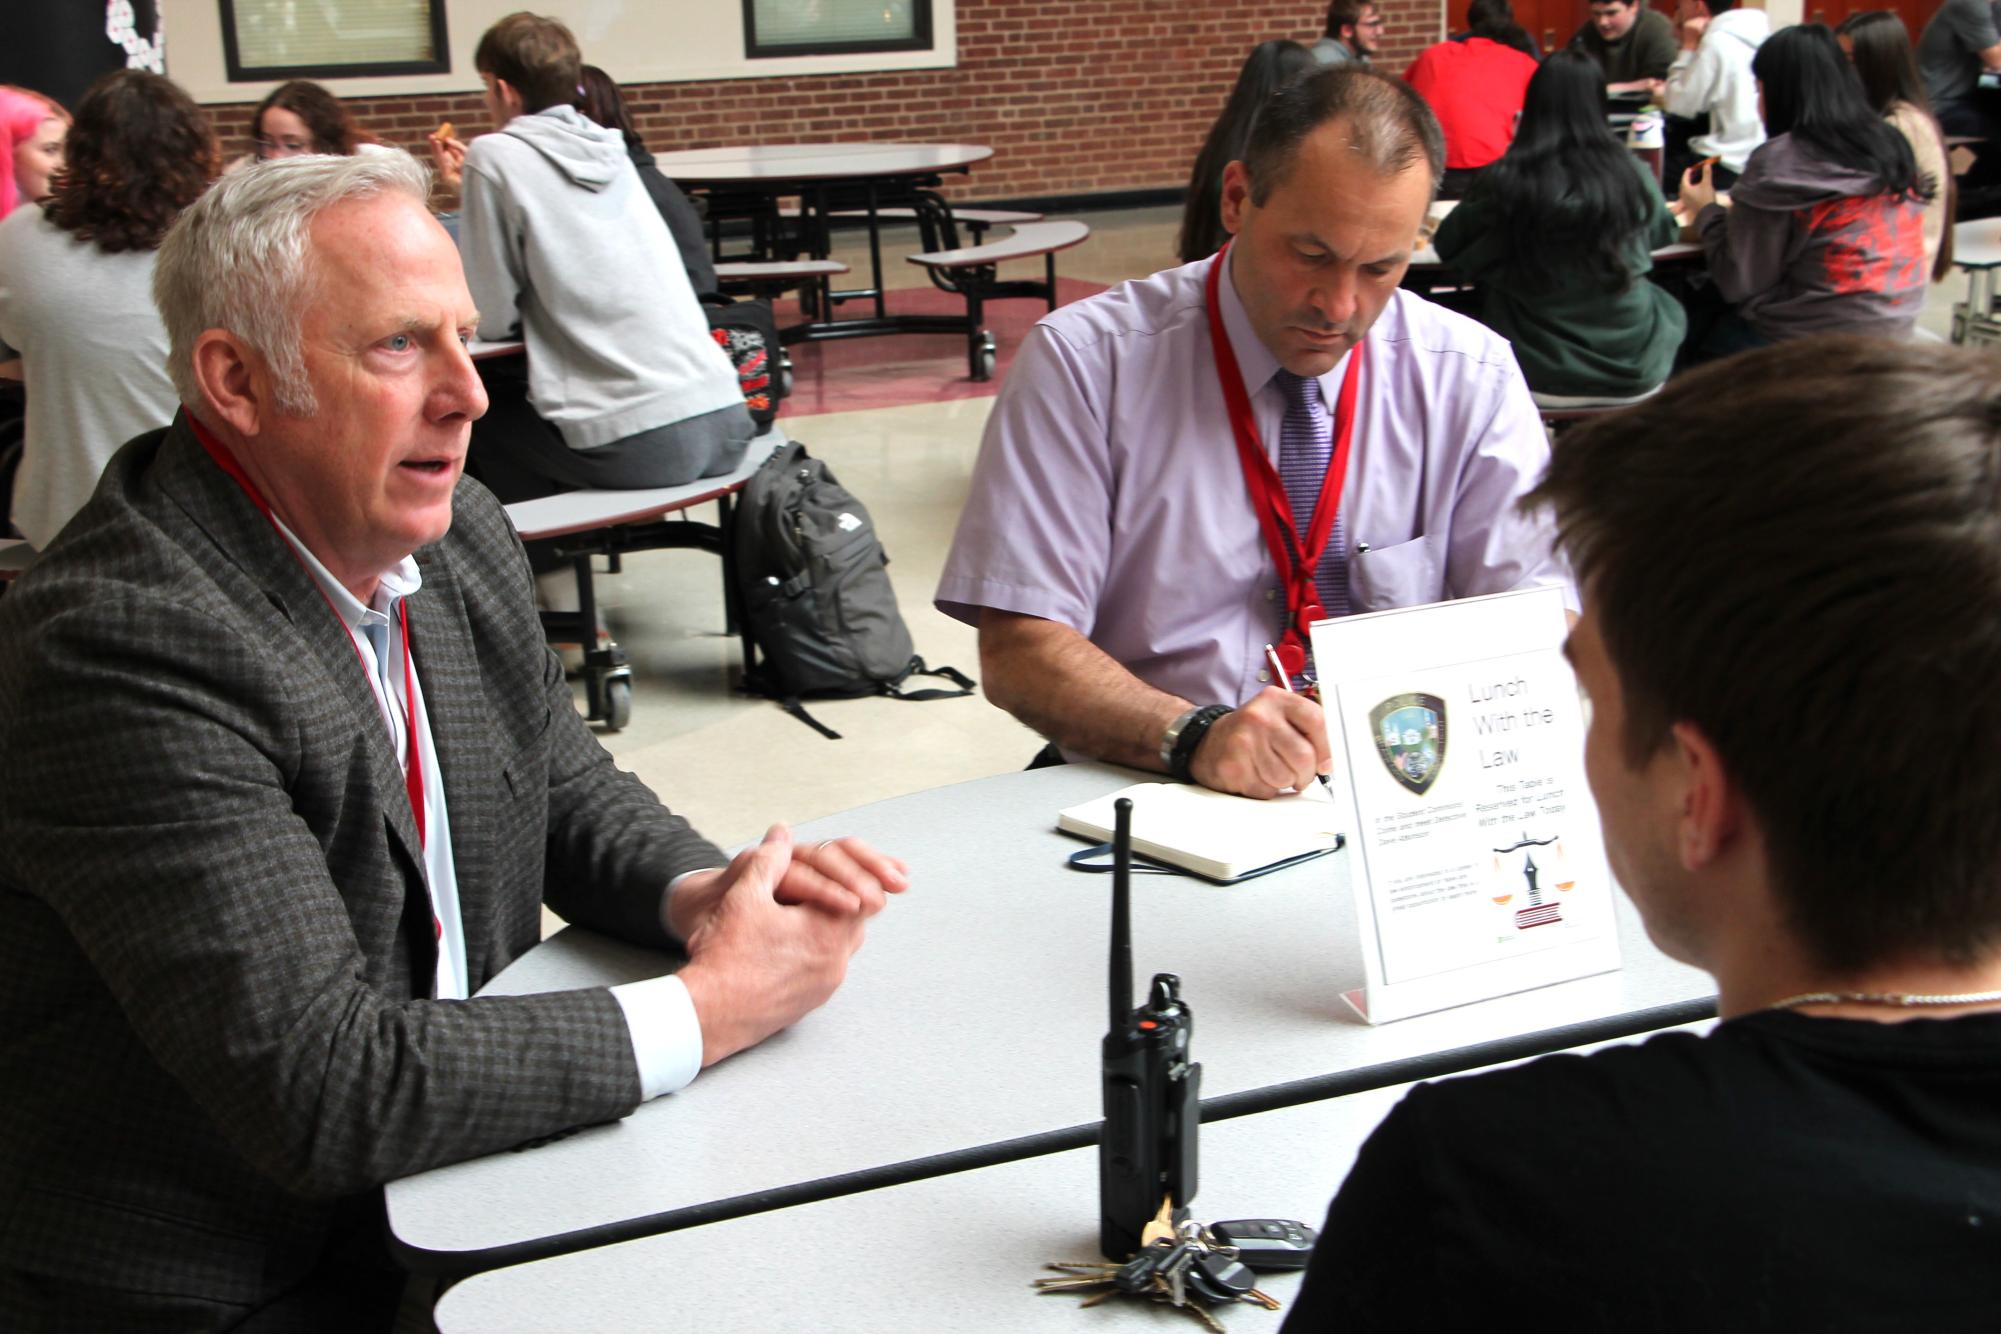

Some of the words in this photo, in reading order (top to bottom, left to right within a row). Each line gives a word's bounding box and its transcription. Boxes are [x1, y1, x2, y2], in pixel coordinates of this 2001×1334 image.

[1468, 676, 1529, 703] Lunch
[1472, 711, 1519, 735] With
[1523, 708, 1554, 727] the
[1479, 749, 1520, 769] Law
[1478, 816, 1498, 827] With
[1501, 814, 1516, 824] the
[1517, 809, 1536, 820] Law
